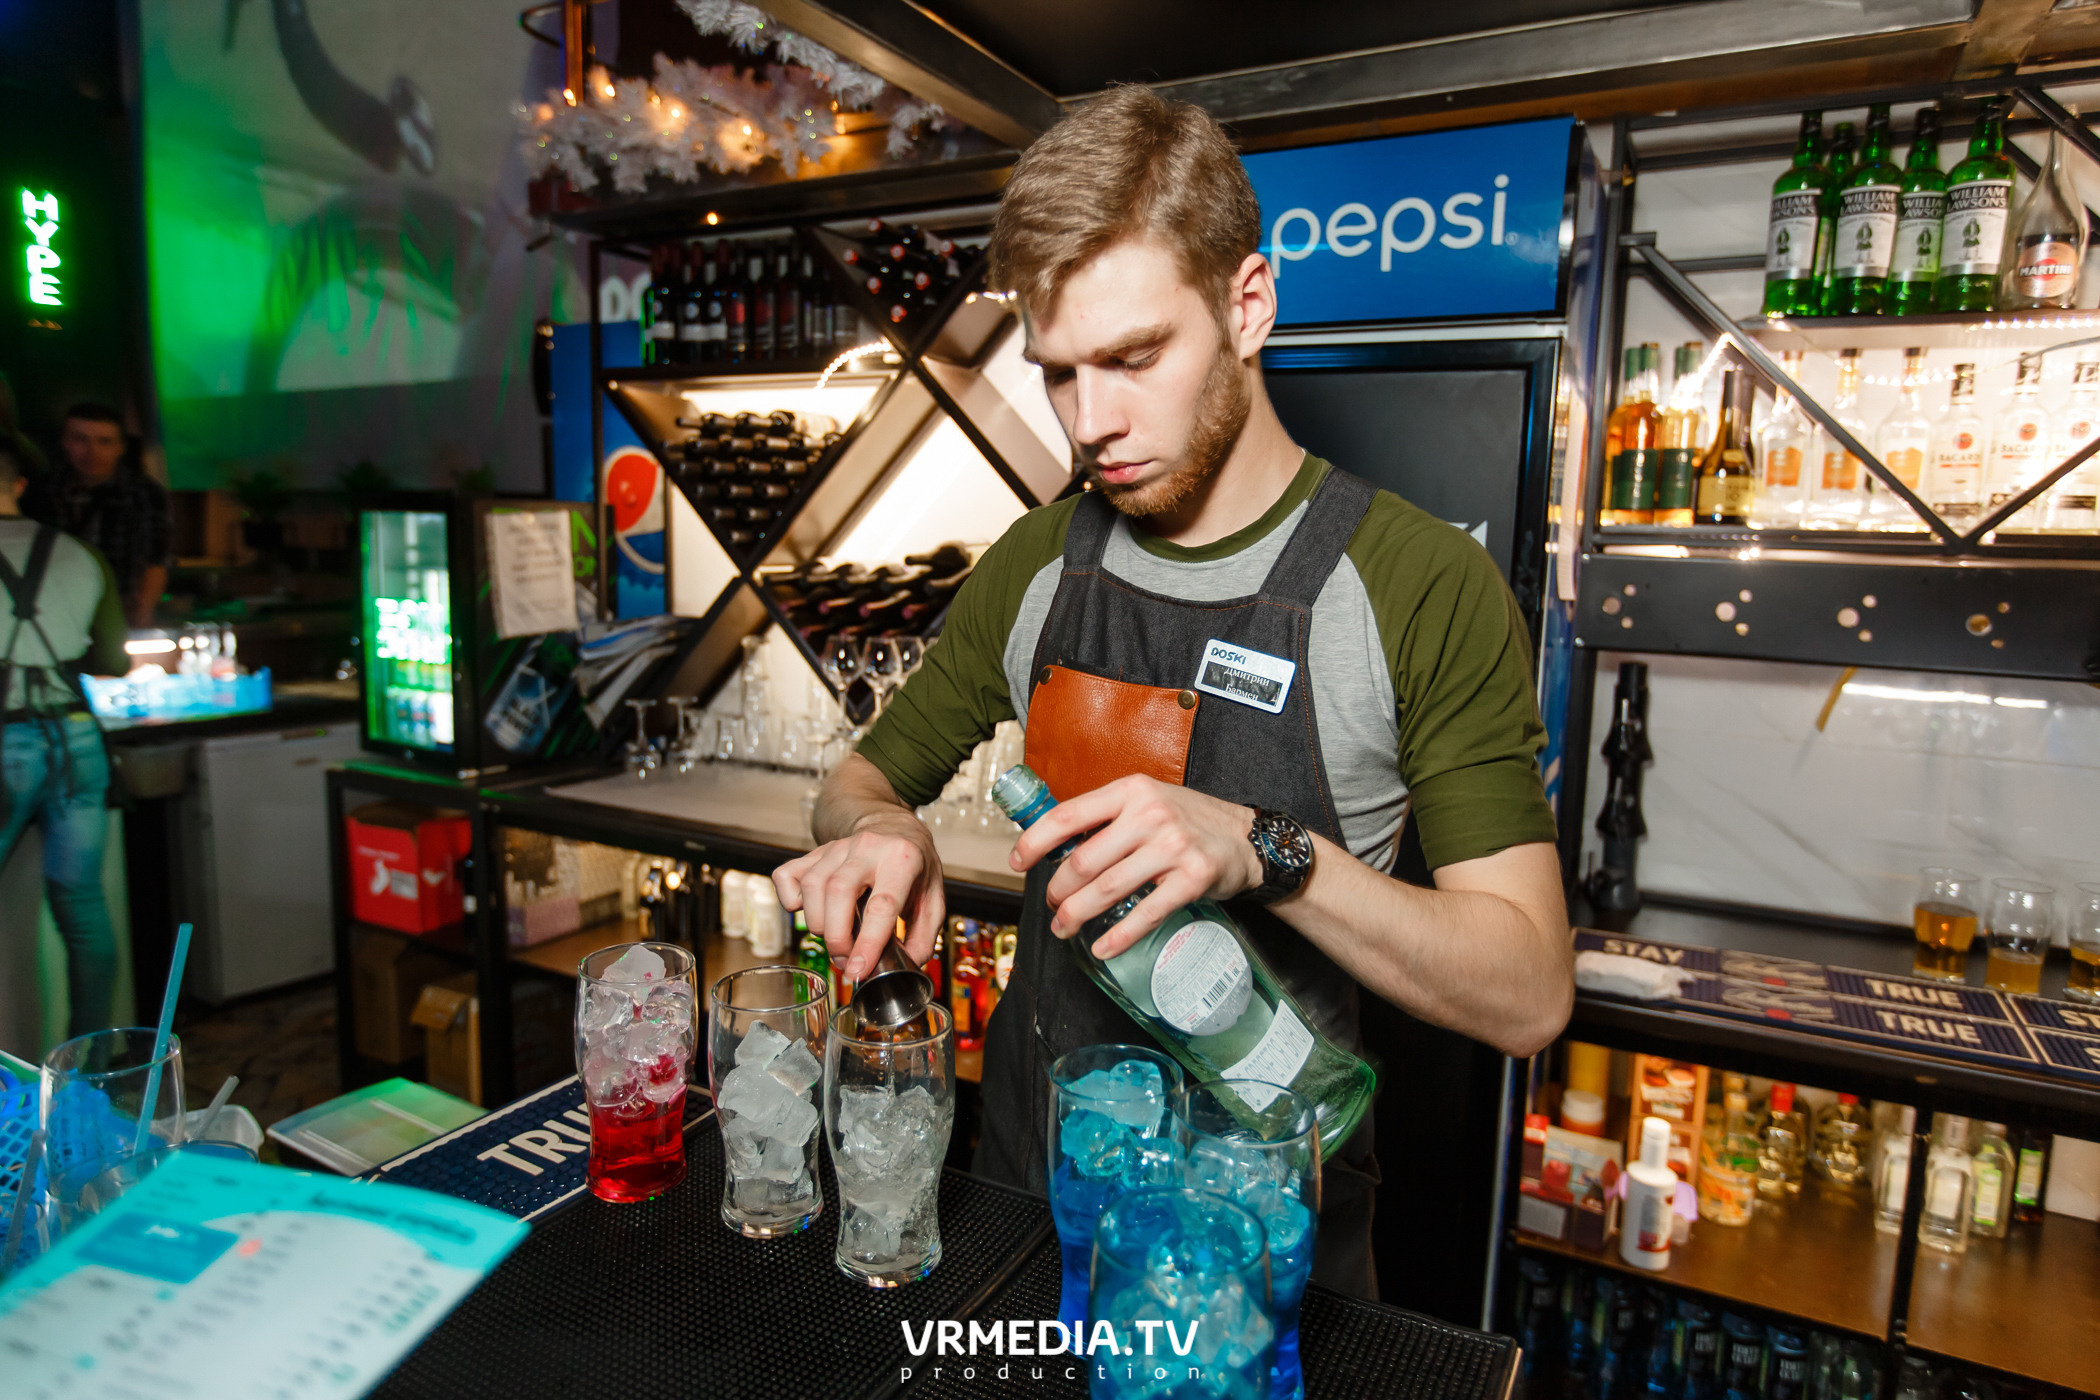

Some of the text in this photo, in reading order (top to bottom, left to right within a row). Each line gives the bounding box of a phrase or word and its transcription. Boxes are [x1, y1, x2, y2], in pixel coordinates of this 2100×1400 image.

[1844, 192, 1895, 204] WILLIAM
[1950, 186, 2007, 201] WILLIAM
[1270, 174, 1509, 280] pepsi
[21, 186, 64, 306] HYPE
[2019, 264, 2072, 277] MARTINI
[1210, 647, 1247, 665] DOSKI
[1603, 939, 1685, 965] STAY
[1864, 978, 1964, 1009] TRUE
[1875, 1009, 1982, 1045] TRUE
[476, 1102, 592, 1177] TRU
